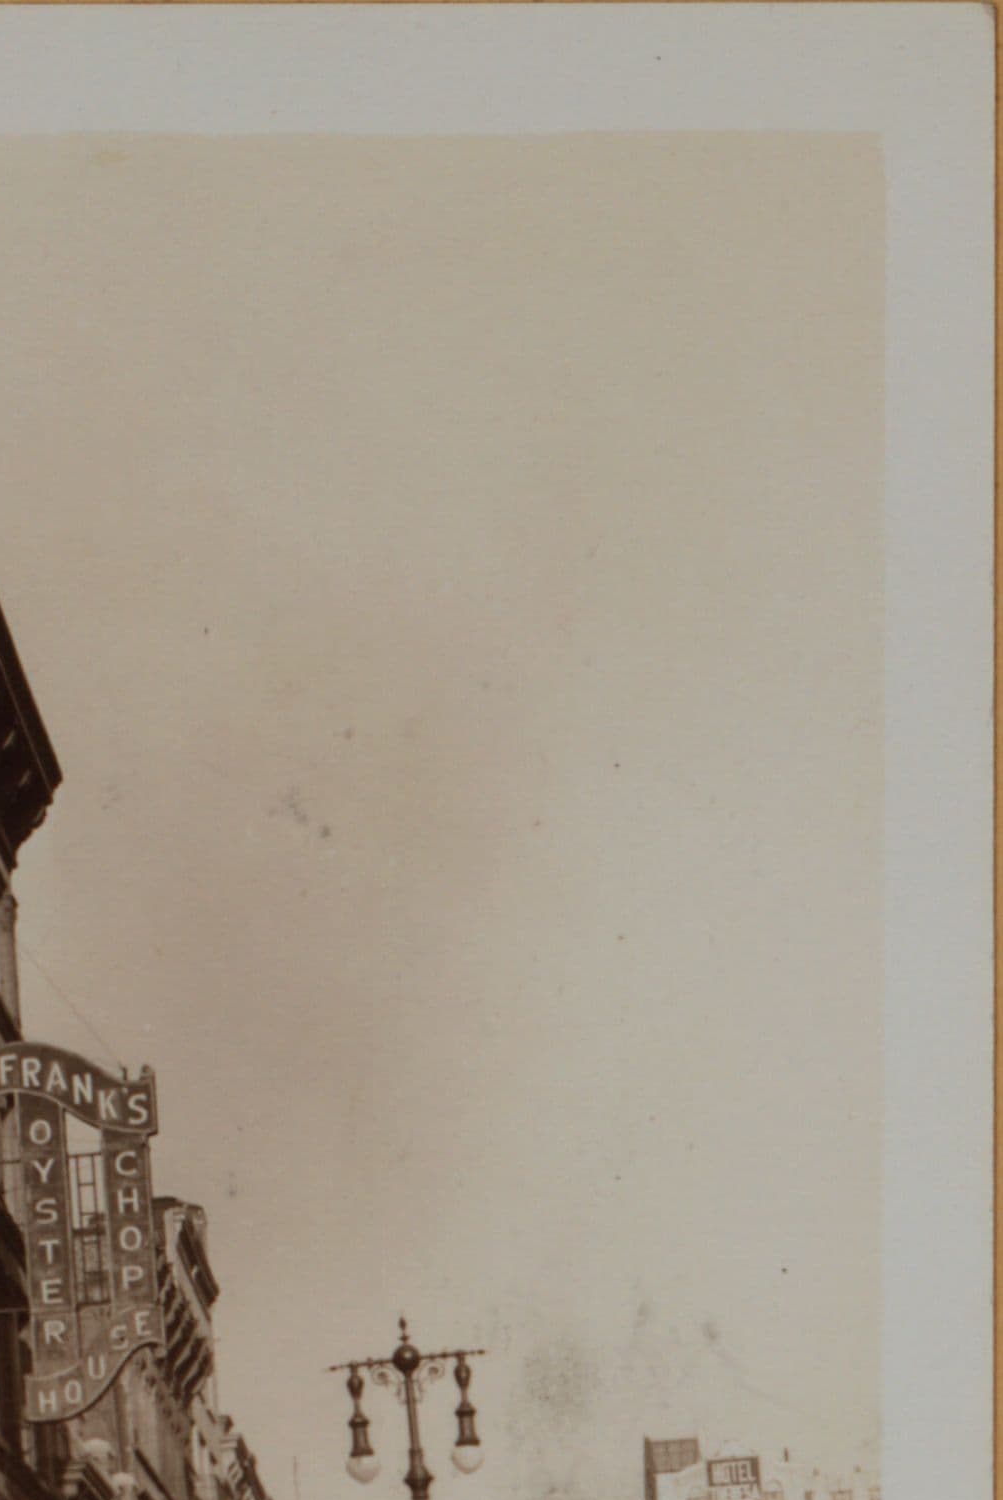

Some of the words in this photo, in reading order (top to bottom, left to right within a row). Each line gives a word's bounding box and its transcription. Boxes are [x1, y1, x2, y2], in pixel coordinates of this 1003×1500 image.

[0, 1054, 148, 1125] FRANK'S
[29, 1119, 65, 1345] OYSTER
[116, 1151, 144, 1290] CHOP
[38, 1310, 153, 1413] HOUSE
